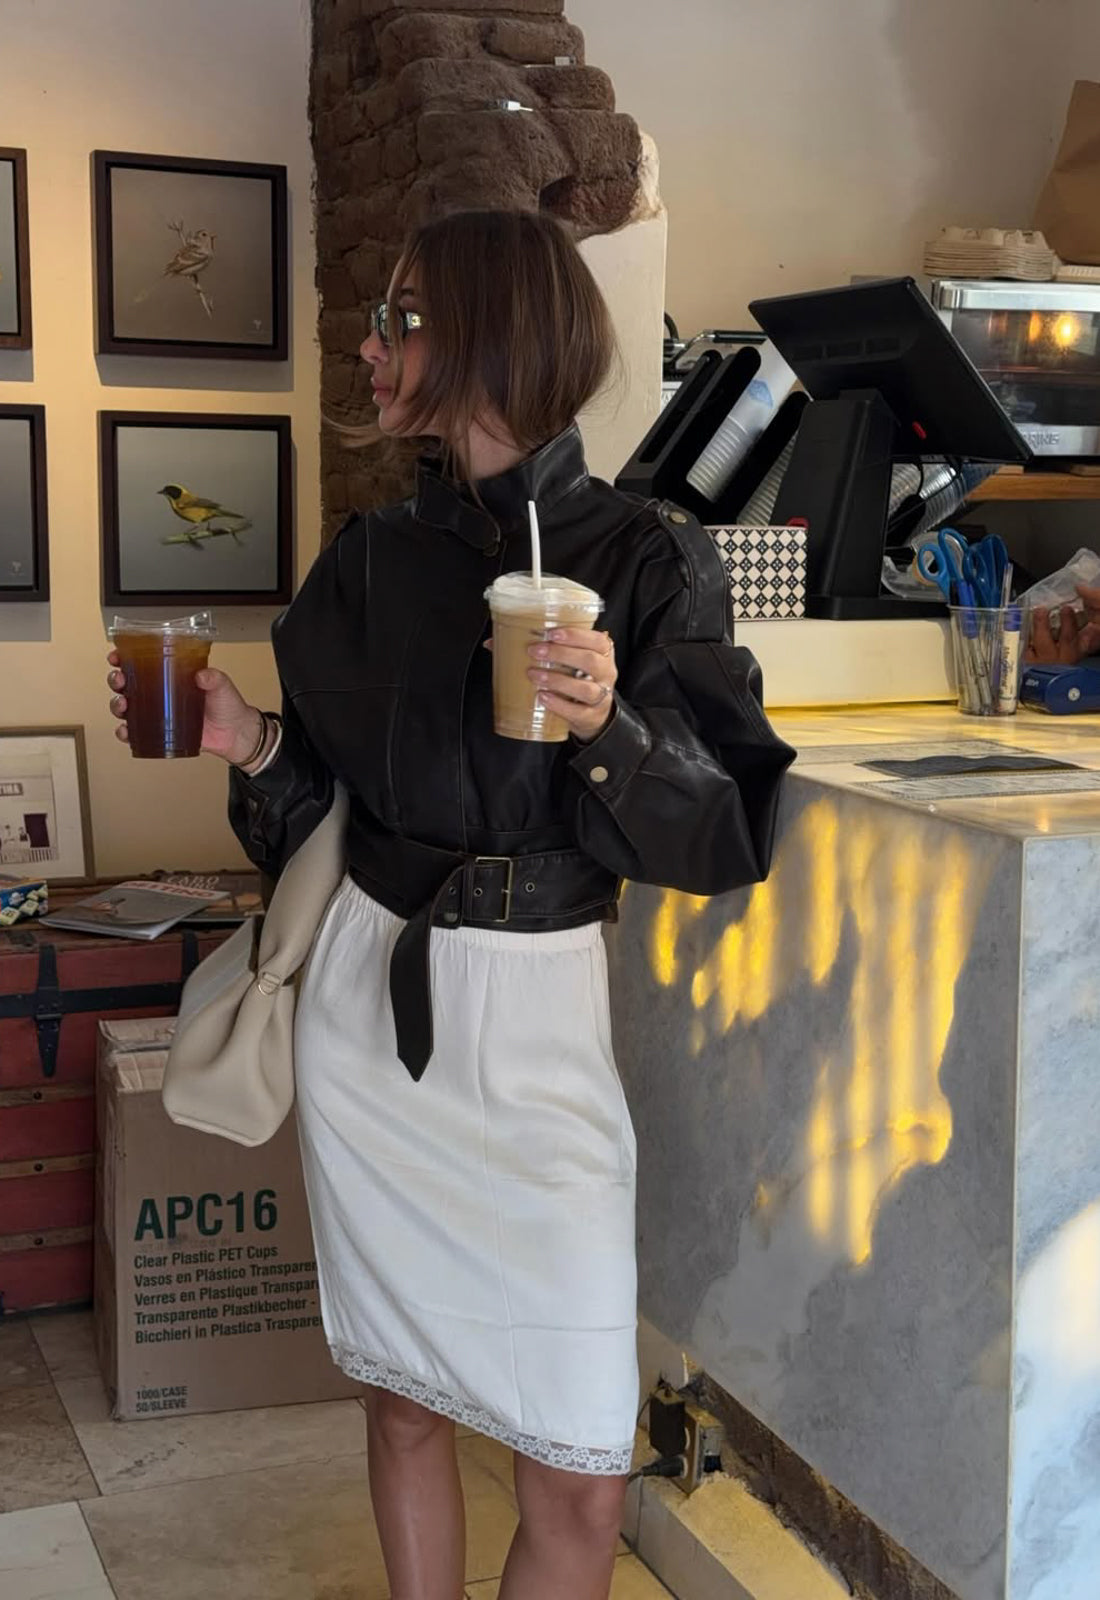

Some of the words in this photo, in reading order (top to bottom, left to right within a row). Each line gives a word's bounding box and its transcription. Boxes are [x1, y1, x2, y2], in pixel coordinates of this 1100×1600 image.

[134, 1189, 277, 1241] APC16
[134, 1255, 167, 1269] Clear
[172, 1250, 215, 1266] Plastic
[219, 1247, 243, 1262] PET
[247, 1246, 278, 1260] Cups
[134, 1274, 172, 1288] Vasos
[176, 1273, 191, 1284] en
[196, 1266, 246, 1283] Plástico
[134, 1292, 176, 1307] Verres
[180, 1290, 195, 1302] en
[200, 1284, 258, 1301] Plastique
[135, 1306, 218, 1326] Transparente
[223, 1297, 307, 1317] Plastikbecher
[135, 1325, 191, 1344] Bicchieri
[195, 1324, 206, 1338] in
[211, 1319, 261, 1337] Plastica
[136, 1385, 188, 1400] 1000/CASE
[136, 1398, 188, 1413] 50/SLEEVE
